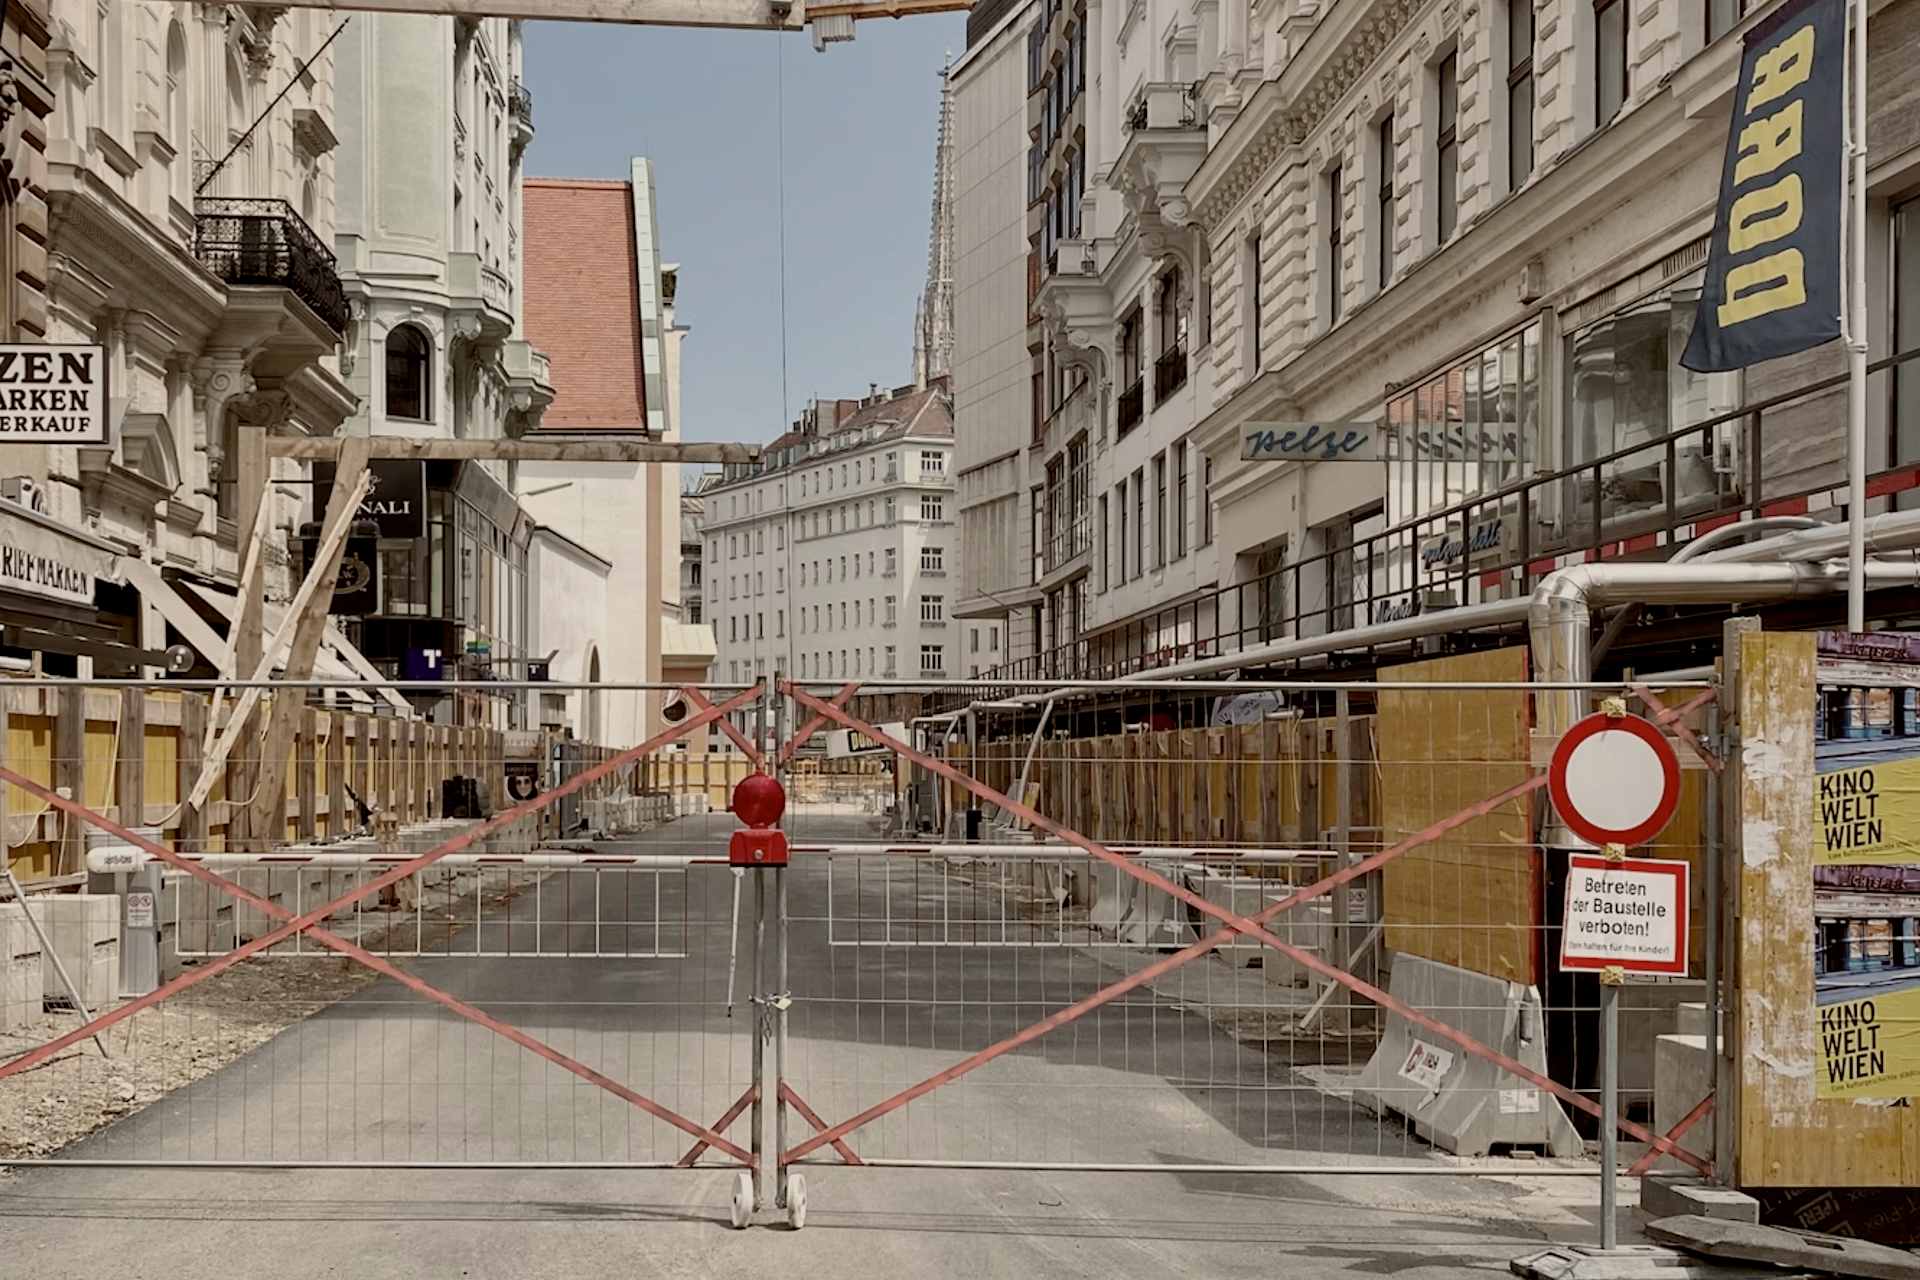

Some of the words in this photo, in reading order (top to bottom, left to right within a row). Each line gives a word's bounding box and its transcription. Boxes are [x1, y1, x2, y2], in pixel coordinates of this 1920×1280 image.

[0, 352, 93, 384] ZEN
[1246, 425, 1369, 458] pelze
[1821, 769, 1874, 800] KINO
[1821, 793, 1879, 826] WELT
[1825, 819, 1882, 851] WIEN
[1585, 877, 1646, 896] Betreten
[1573, 897, 1589, 912] der
[1594, 898, 1666, 917] Baustelle
[1579, 918, 1649, 937] verboten!
[1822, 1001, 1875, 1033] KINO
[1823, 1025, 1881, 1058] WELT
[1827, 1050, 1884, 1083] WIEN
